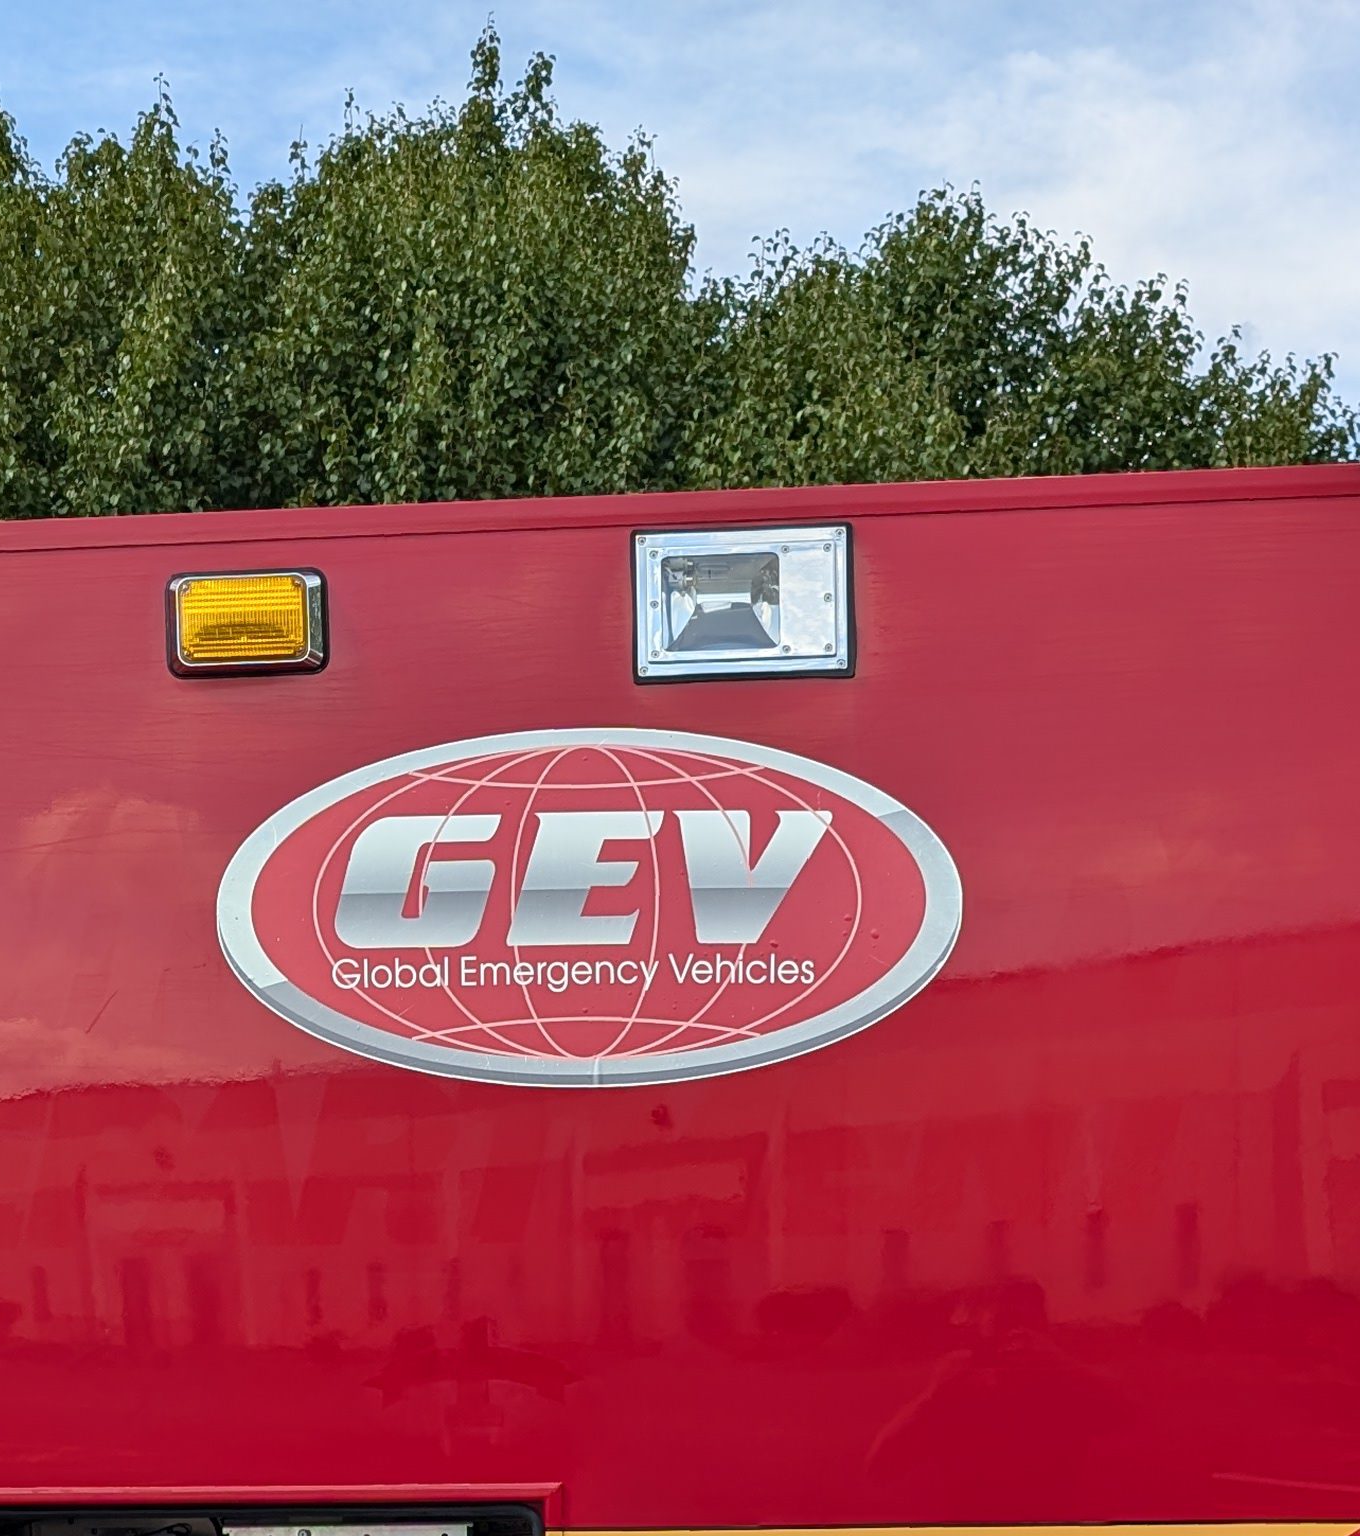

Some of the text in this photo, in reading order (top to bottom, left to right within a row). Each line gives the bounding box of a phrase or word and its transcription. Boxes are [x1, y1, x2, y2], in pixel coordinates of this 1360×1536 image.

[333, 809, 832, 949] GEV
[331, 953, 815, 993] Global Emergency Vehicles
